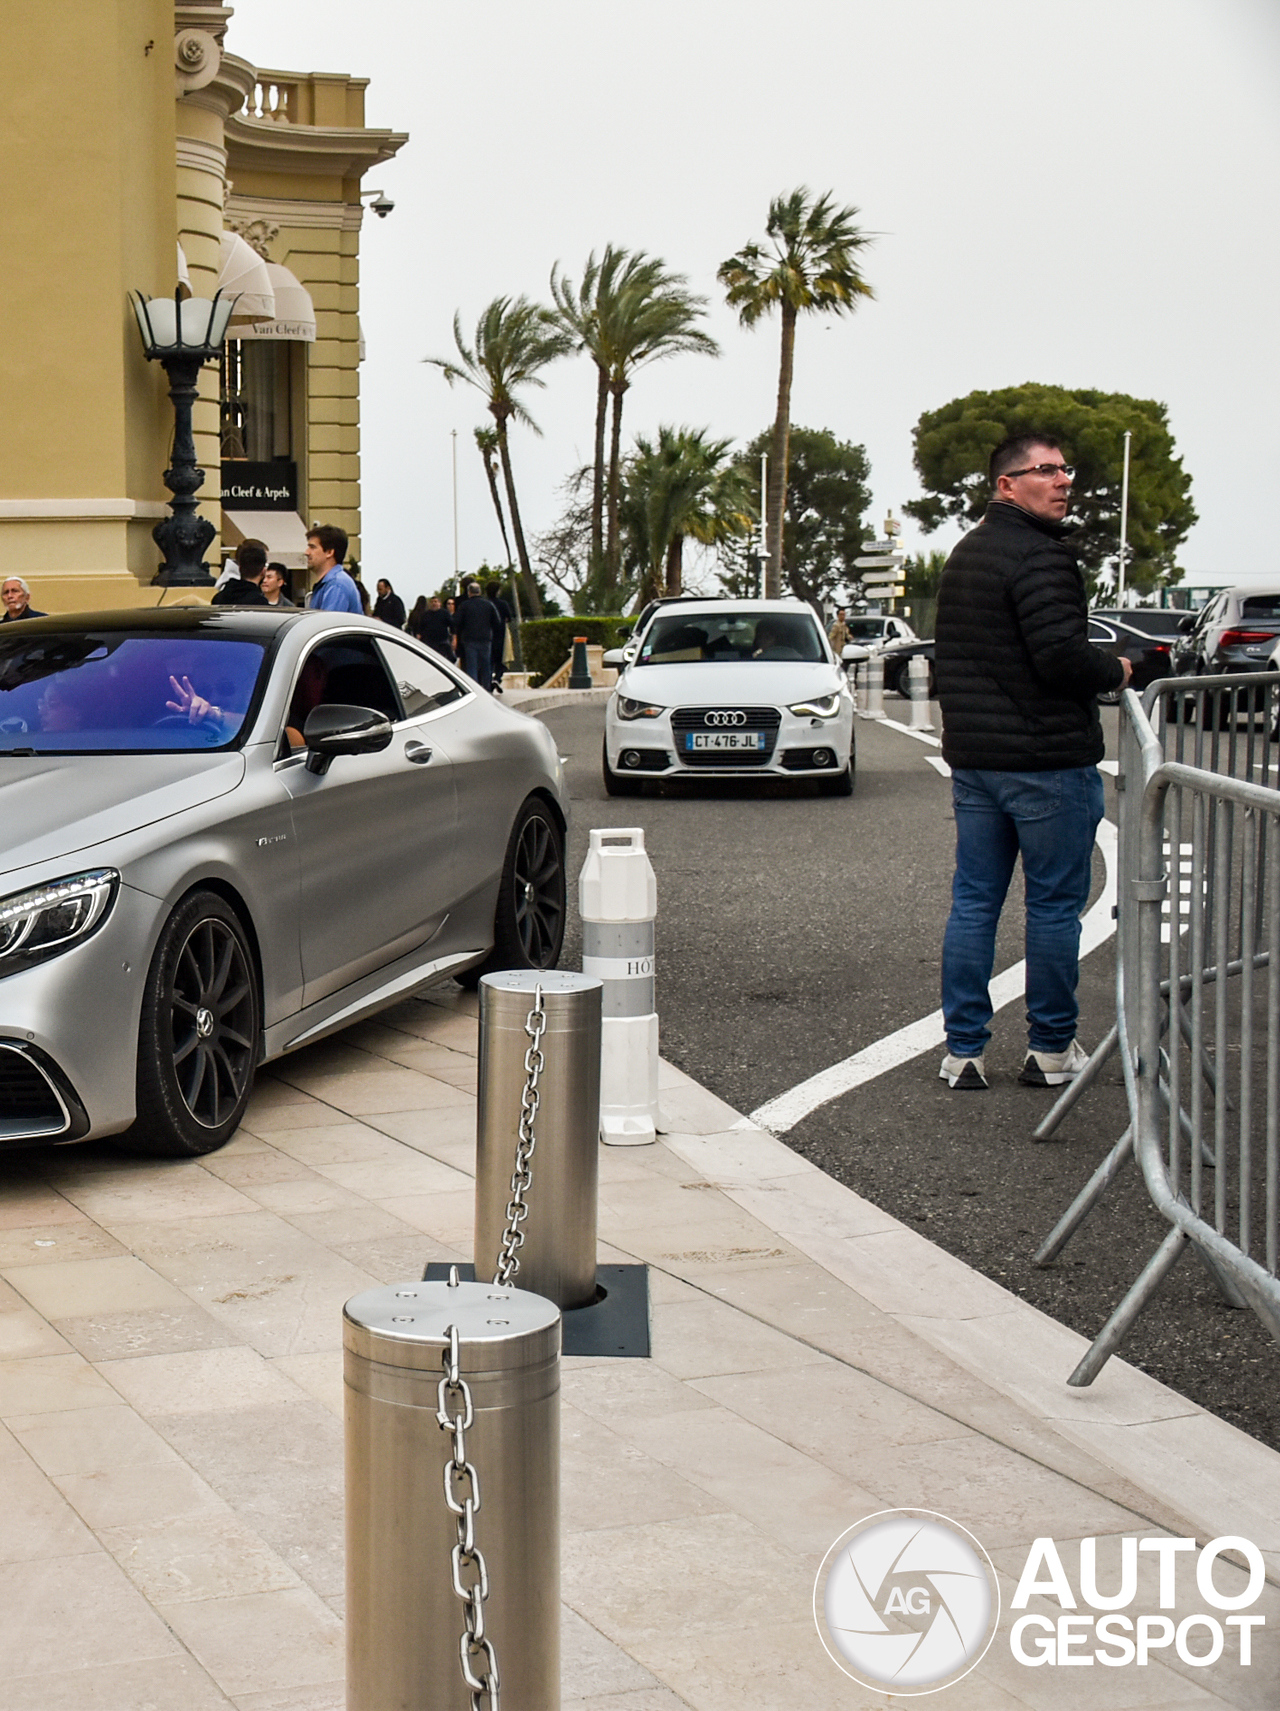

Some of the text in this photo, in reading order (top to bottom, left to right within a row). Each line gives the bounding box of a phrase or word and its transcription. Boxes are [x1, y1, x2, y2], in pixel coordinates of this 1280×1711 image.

[276, 324, 300, 335] Cleef
[231, 485, 255, 498] Cleef
[255, 488, 262, 498] &
[264, 486, 290, 501] Arpels
